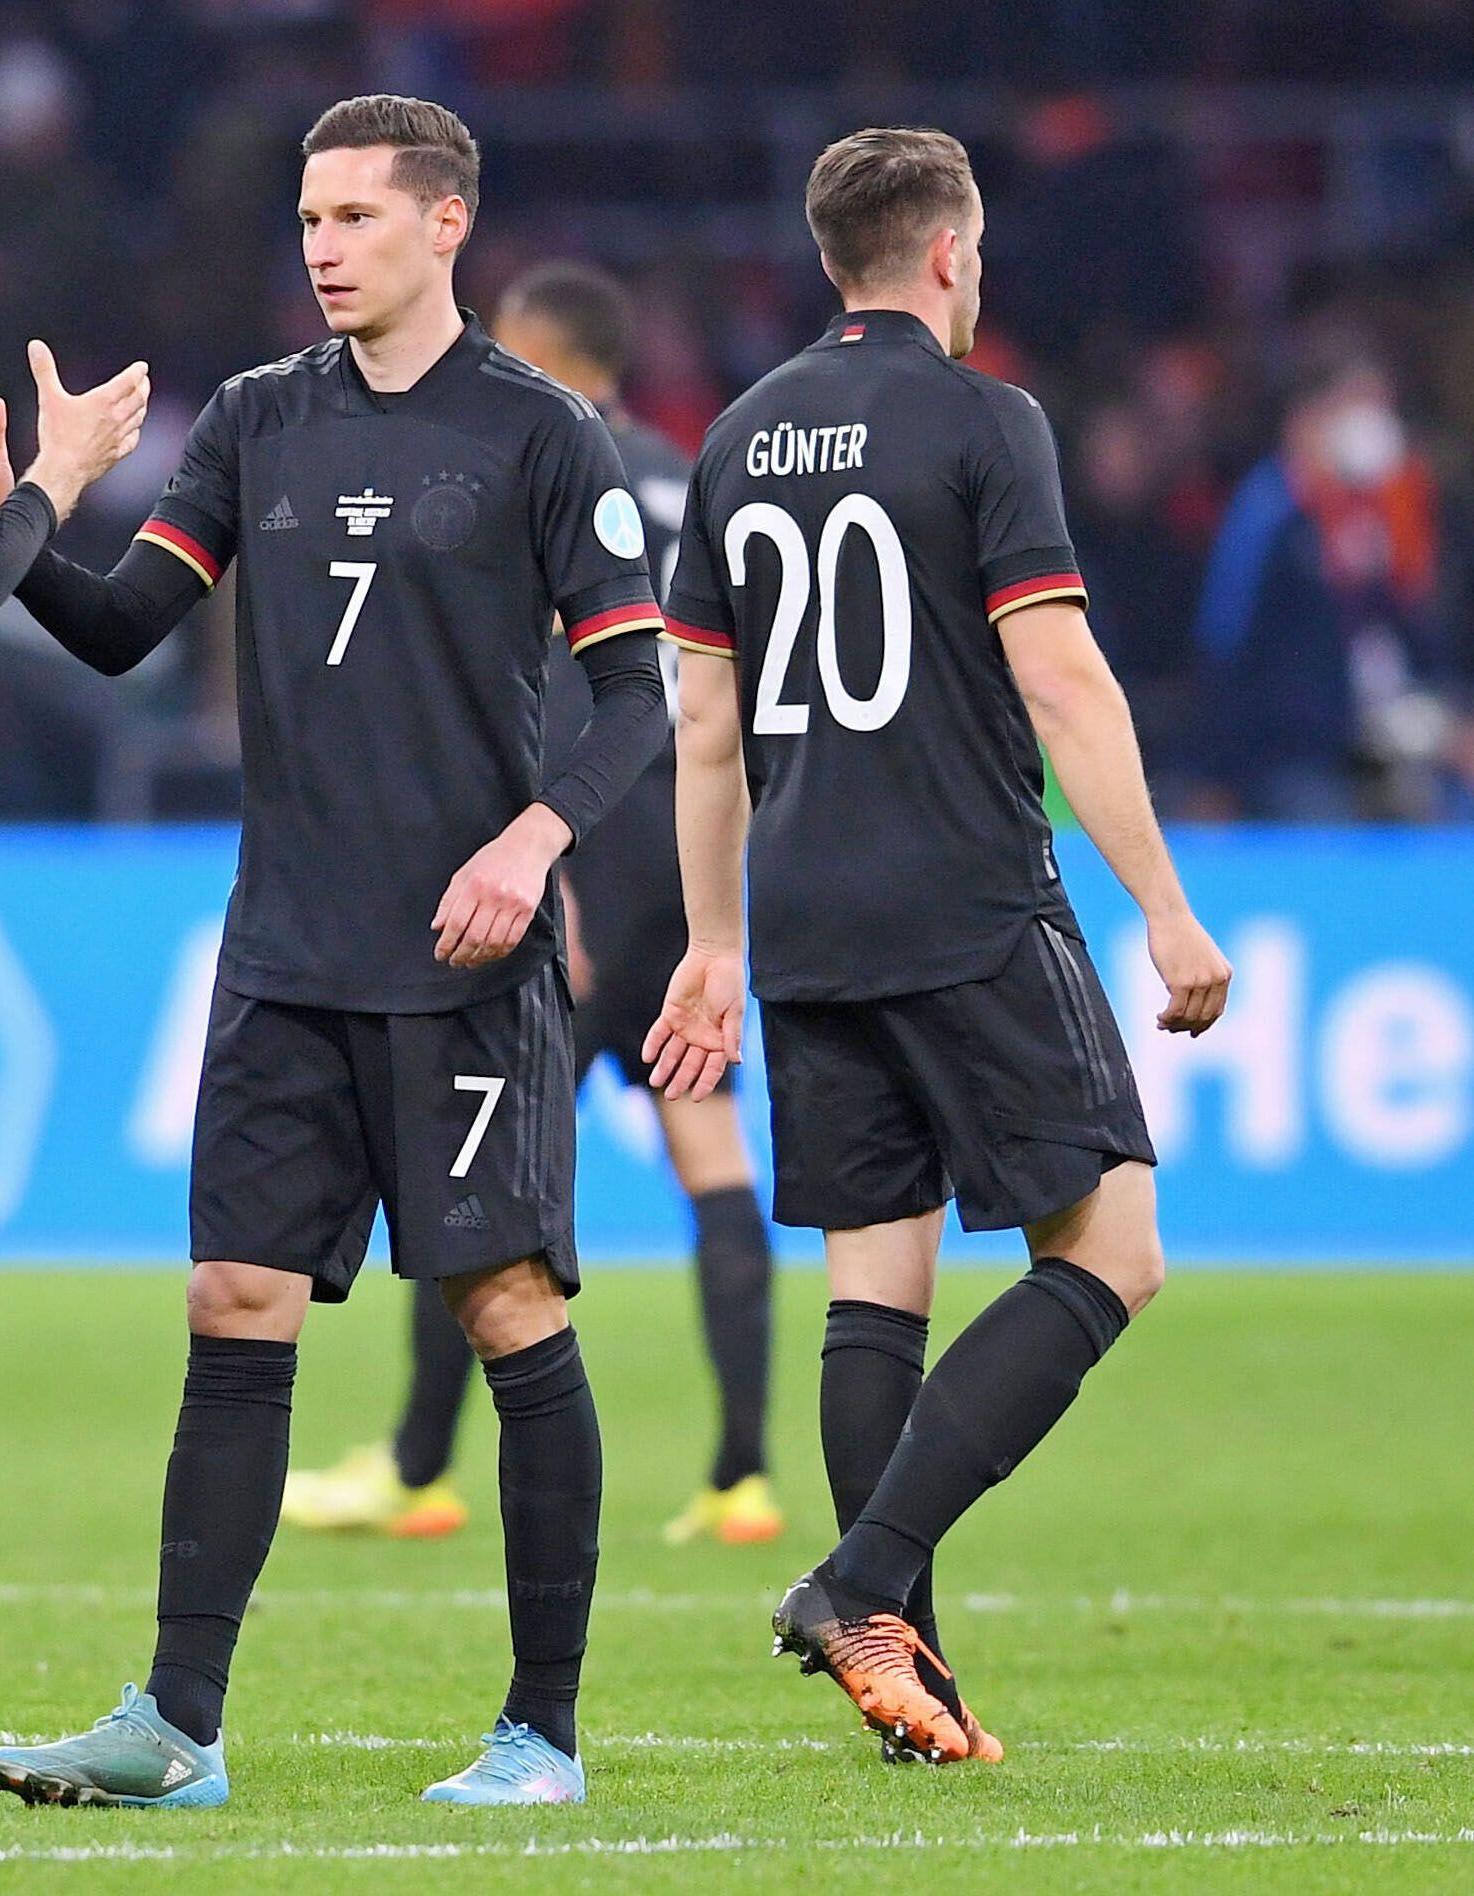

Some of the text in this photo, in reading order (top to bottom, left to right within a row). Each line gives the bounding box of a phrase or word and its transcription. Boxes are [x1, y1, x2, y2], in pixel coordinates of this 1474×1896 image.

[746, 422, 868, 477] GÜNTER
[260, 518, 300, 531] adidas
[326, 561, 377, 666] 7
[723, 493, 912, 735] 20
[449, 1075, 506, 1178] 7
